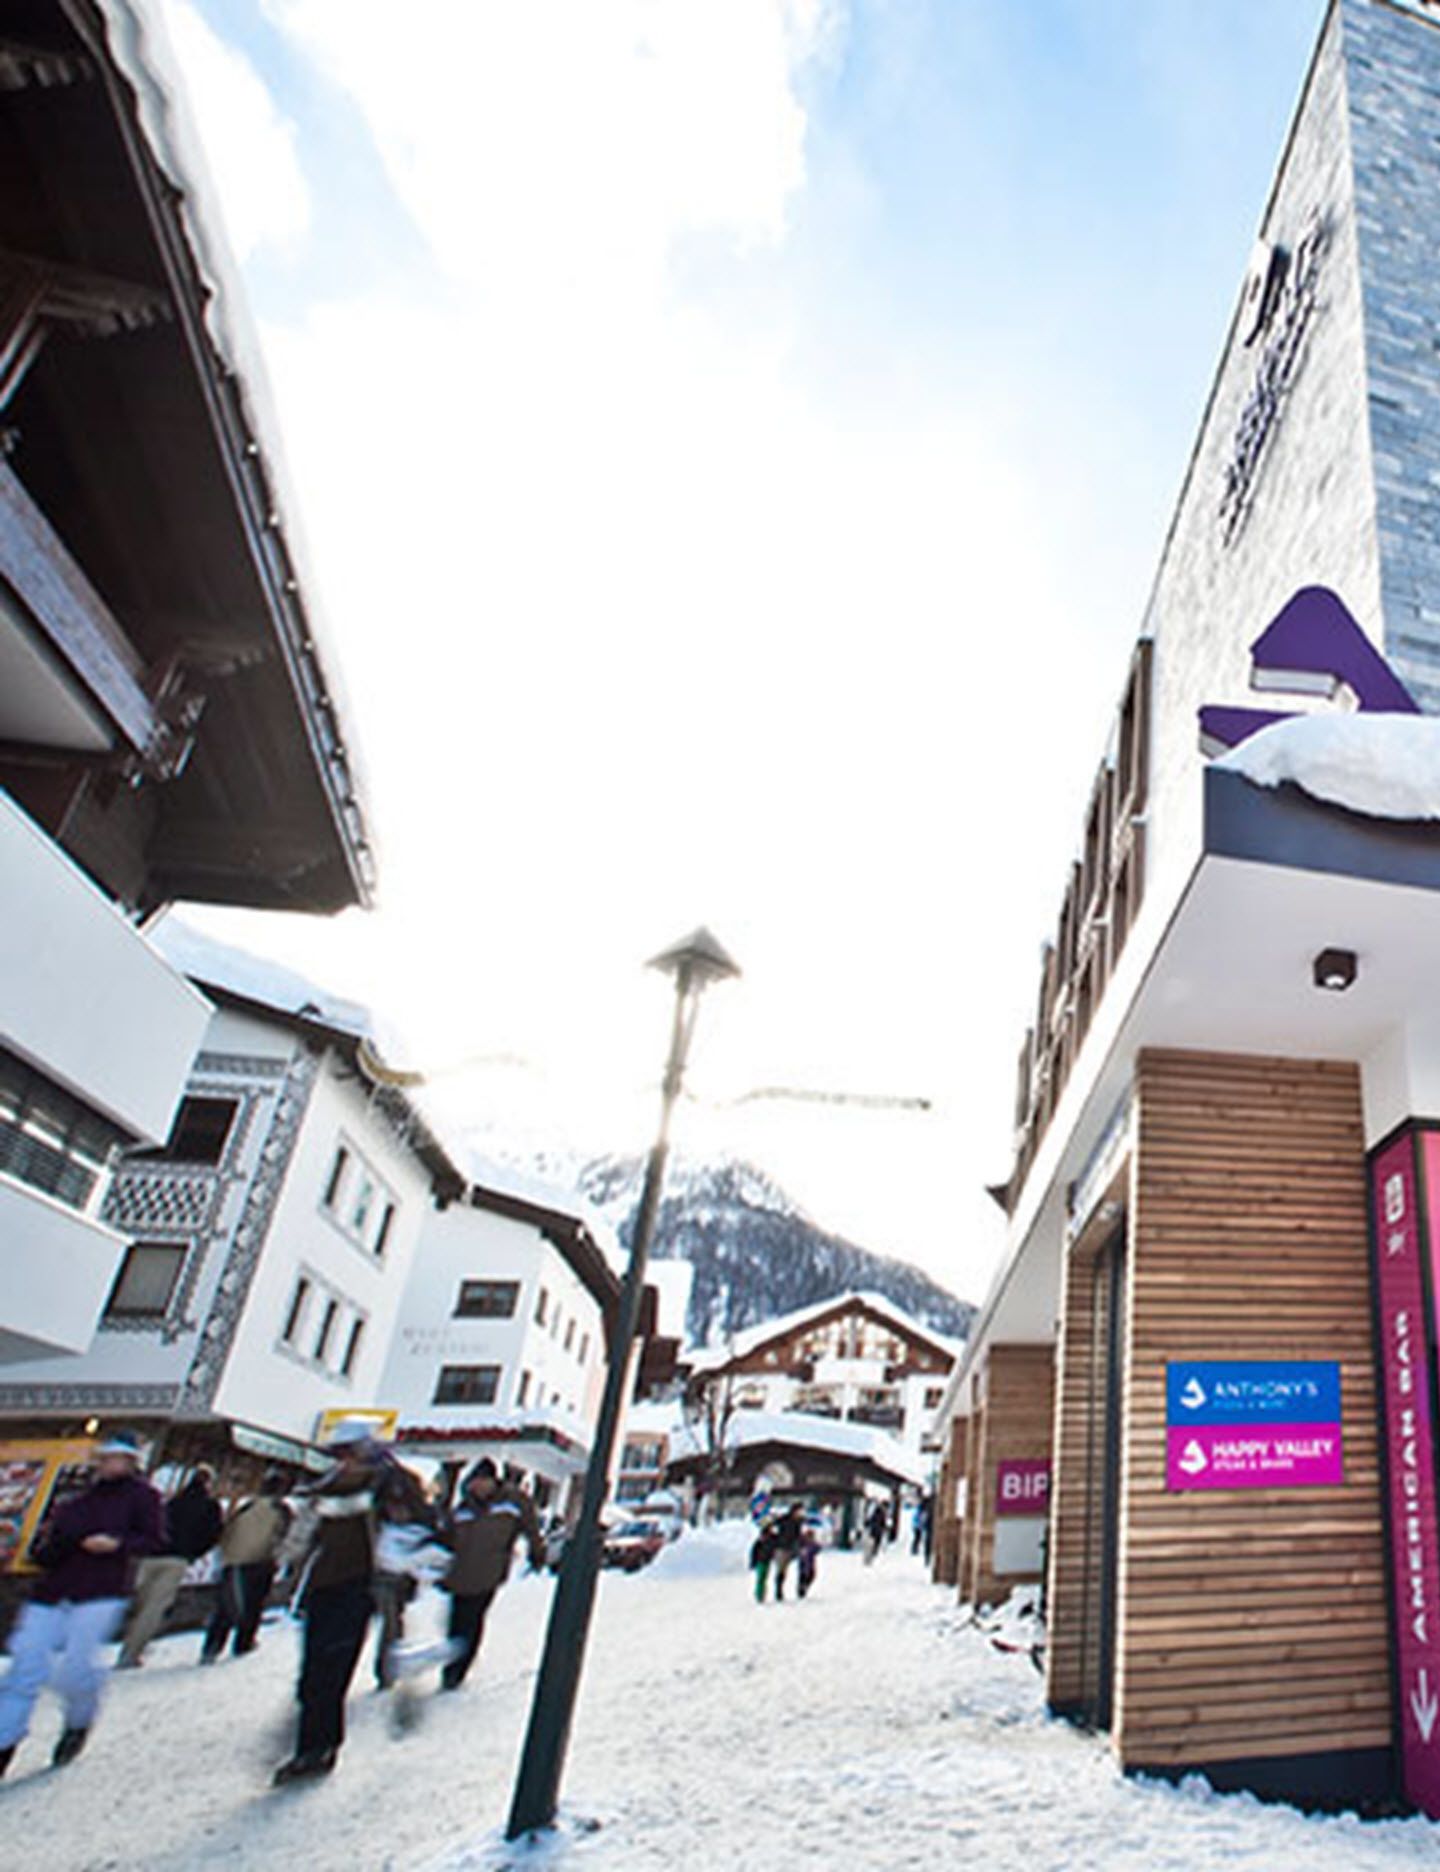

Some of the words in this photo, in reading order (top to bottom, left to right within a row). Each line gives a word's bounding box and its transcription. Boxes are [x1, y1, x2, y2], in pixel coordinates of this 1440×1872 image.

[1395, 1311, 1412, 1393] BAR
[1212, 1438, 1269, 1457] HAPPY
[1273, 1438, 1333, 1458] VALLEY
[1402, 1408, 1429, 1643] AMERICAN
